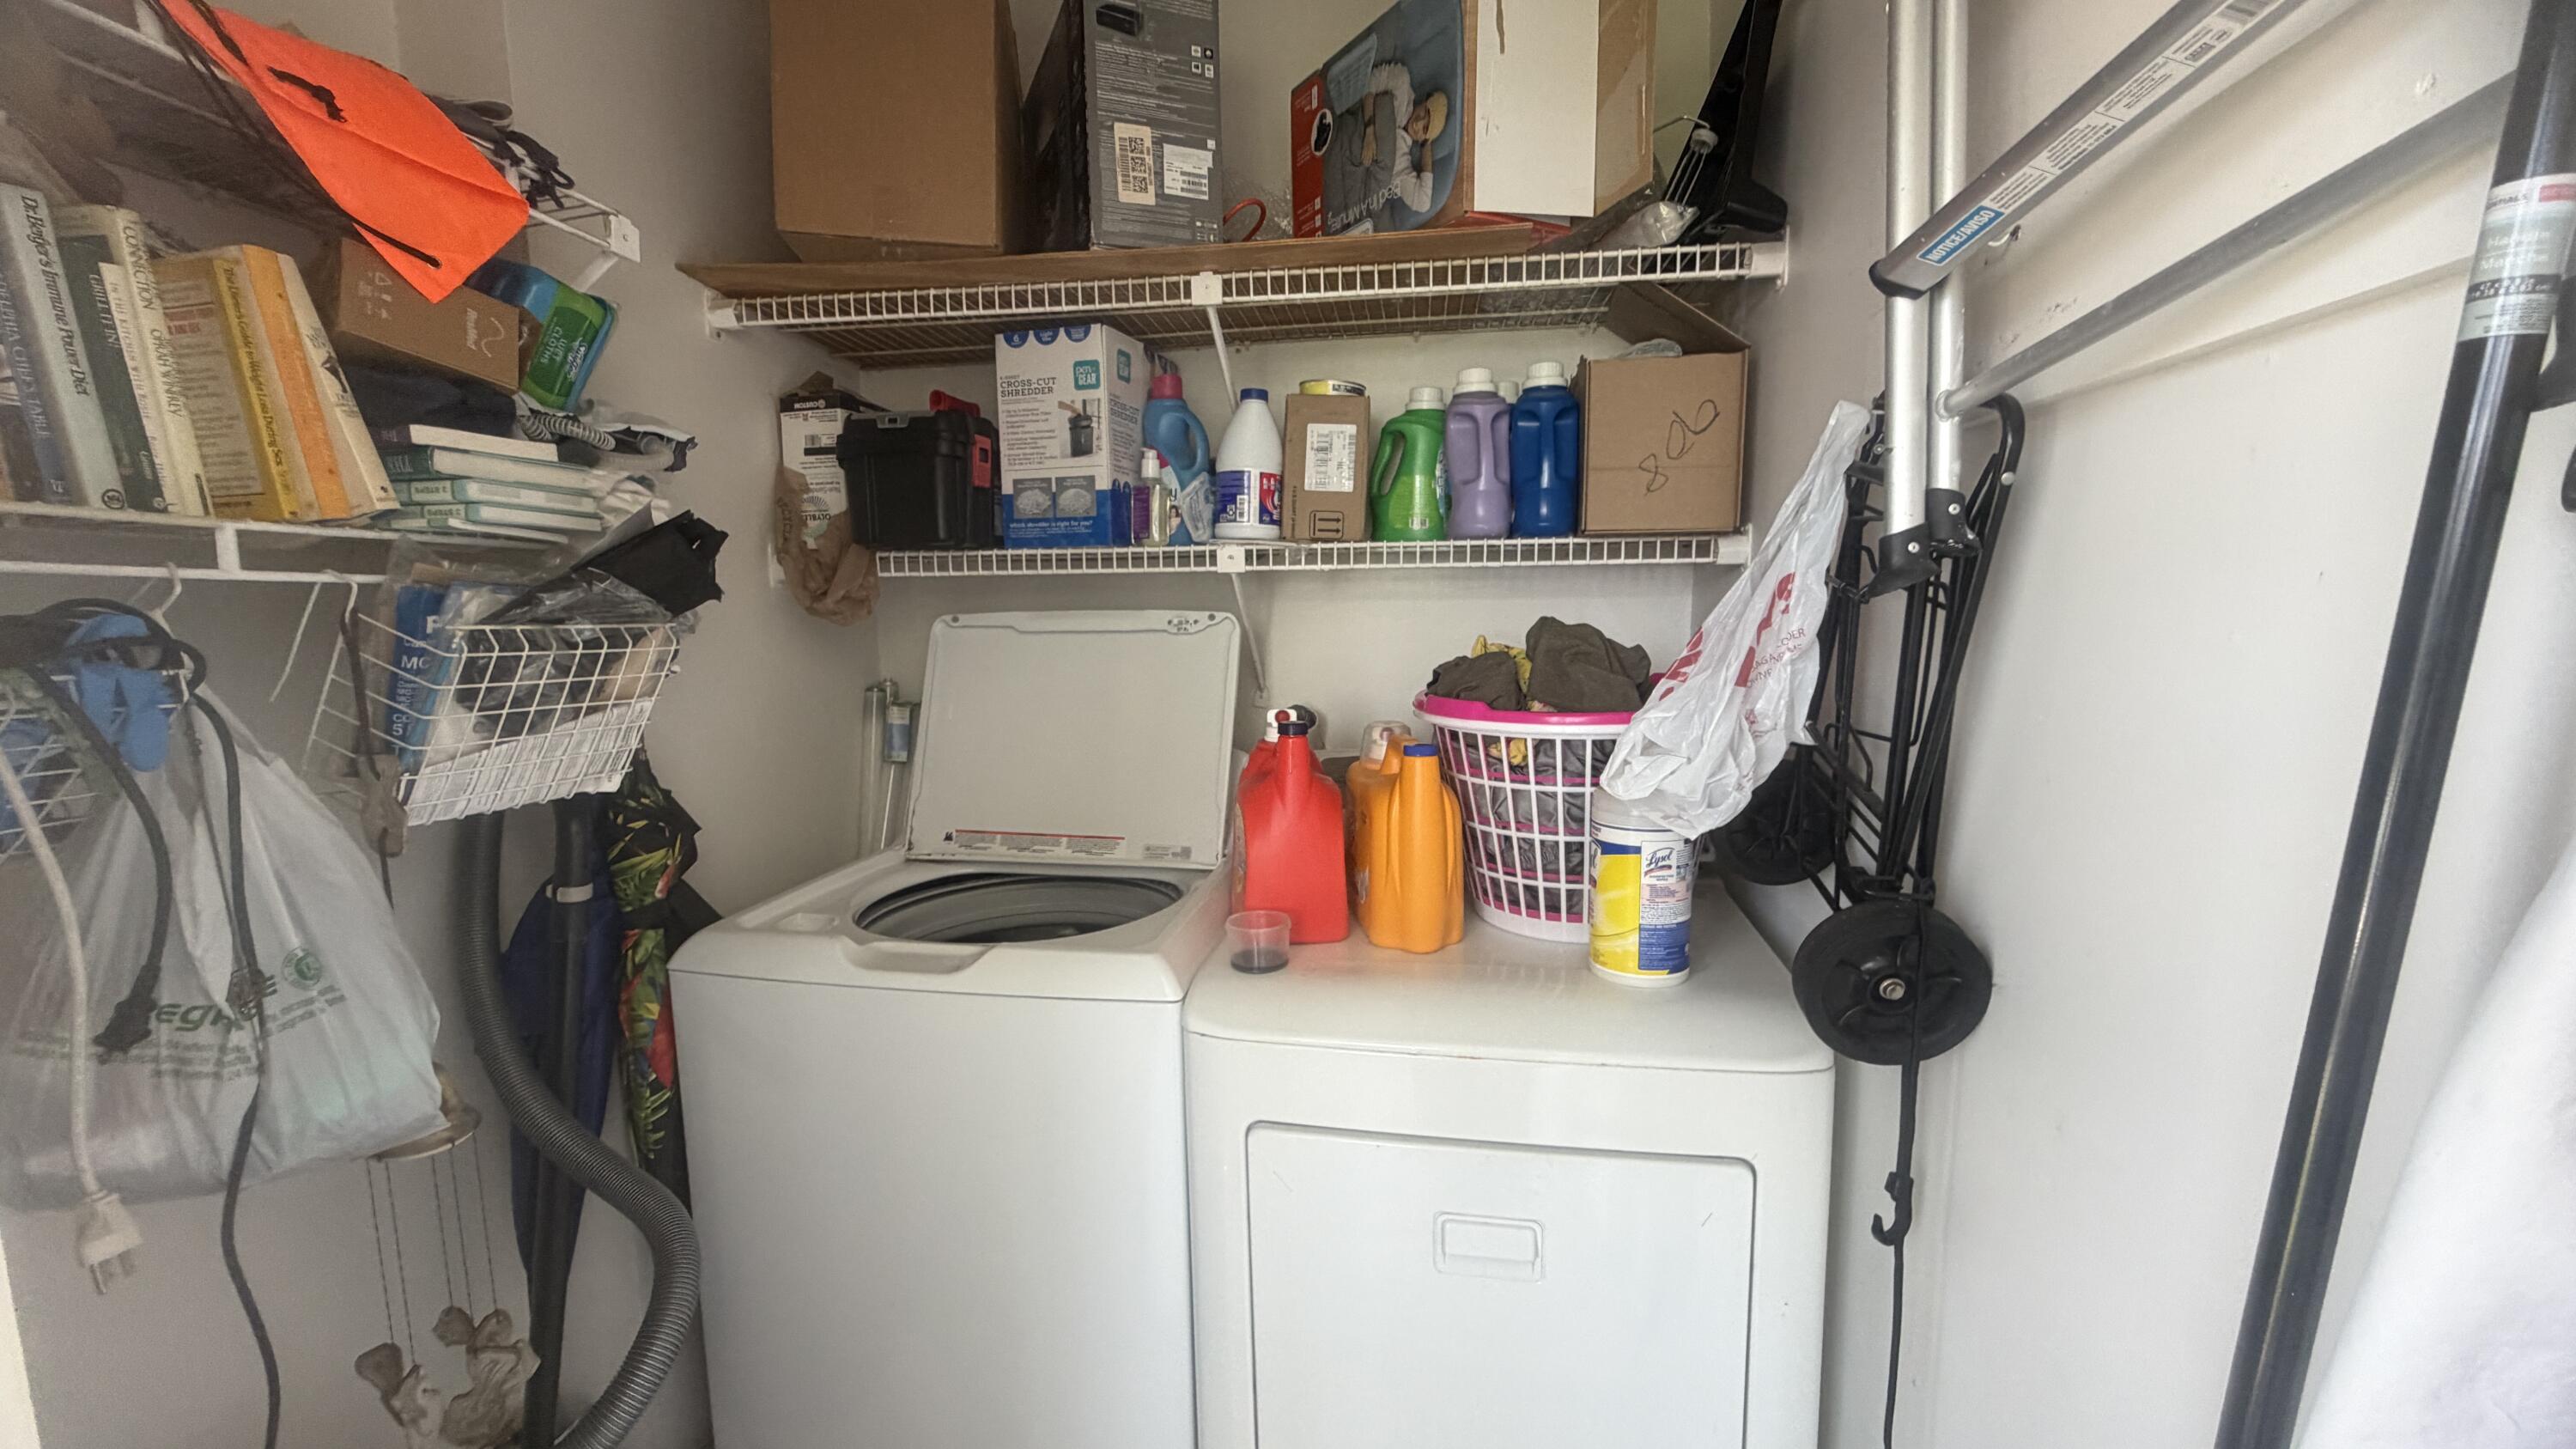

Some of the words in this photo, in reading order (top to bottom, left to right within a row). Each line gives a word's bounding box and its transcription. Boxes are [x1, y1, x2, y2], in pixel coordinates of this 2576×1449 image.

[1926, 210, 1996, 261] NOTICE/AVISO
[123, 225, 160, 310] CONNECTION
[42, 267, 69, 331] Immune
[58, 325, 81, 368] Power
[70, 366, 90, 397] Diet
[150, 328, 173, 373] OPRAH
[540, 326, 563, 364] CLOTHS
[999, 377, 1057, 389] CROSS-CUT
[1000, 387, 1054, 398] SHREDDER
[1078, 374, 1097, 386] GEAR
[1646, 849, 1674, 868] Lysol
